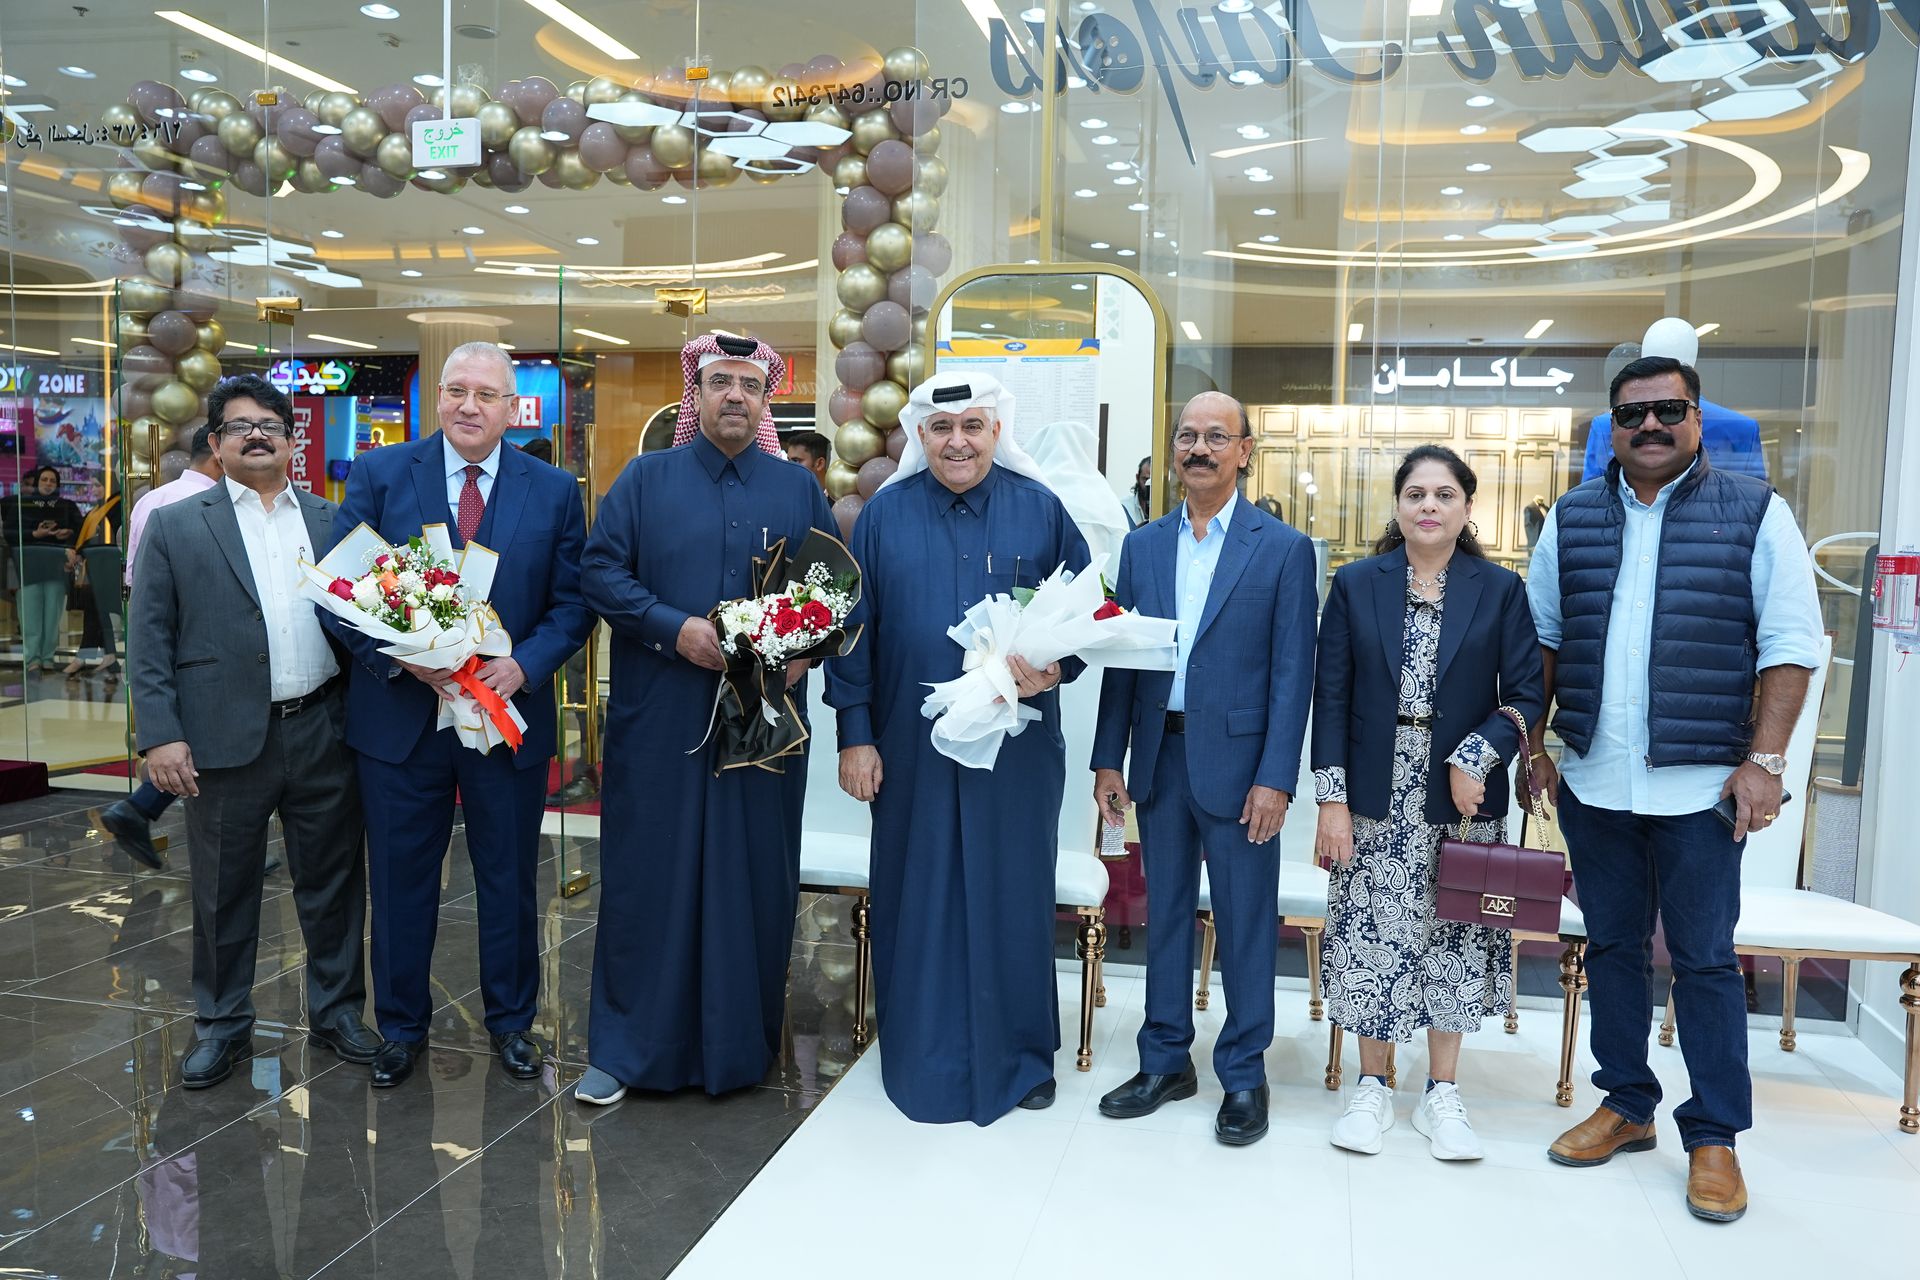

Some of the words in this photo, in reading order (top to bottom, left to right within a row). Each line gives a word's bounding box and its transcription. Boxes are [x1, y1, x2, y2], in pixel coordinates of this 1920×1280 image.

[424, 122, 464, 144] خروج
[430, 144, 459, 160] EXIT
[38, 374, 85, 394] ZONE
[266, 359, 347, 395] كيدي
[1373, 357, 1575, 395] جاكامان
